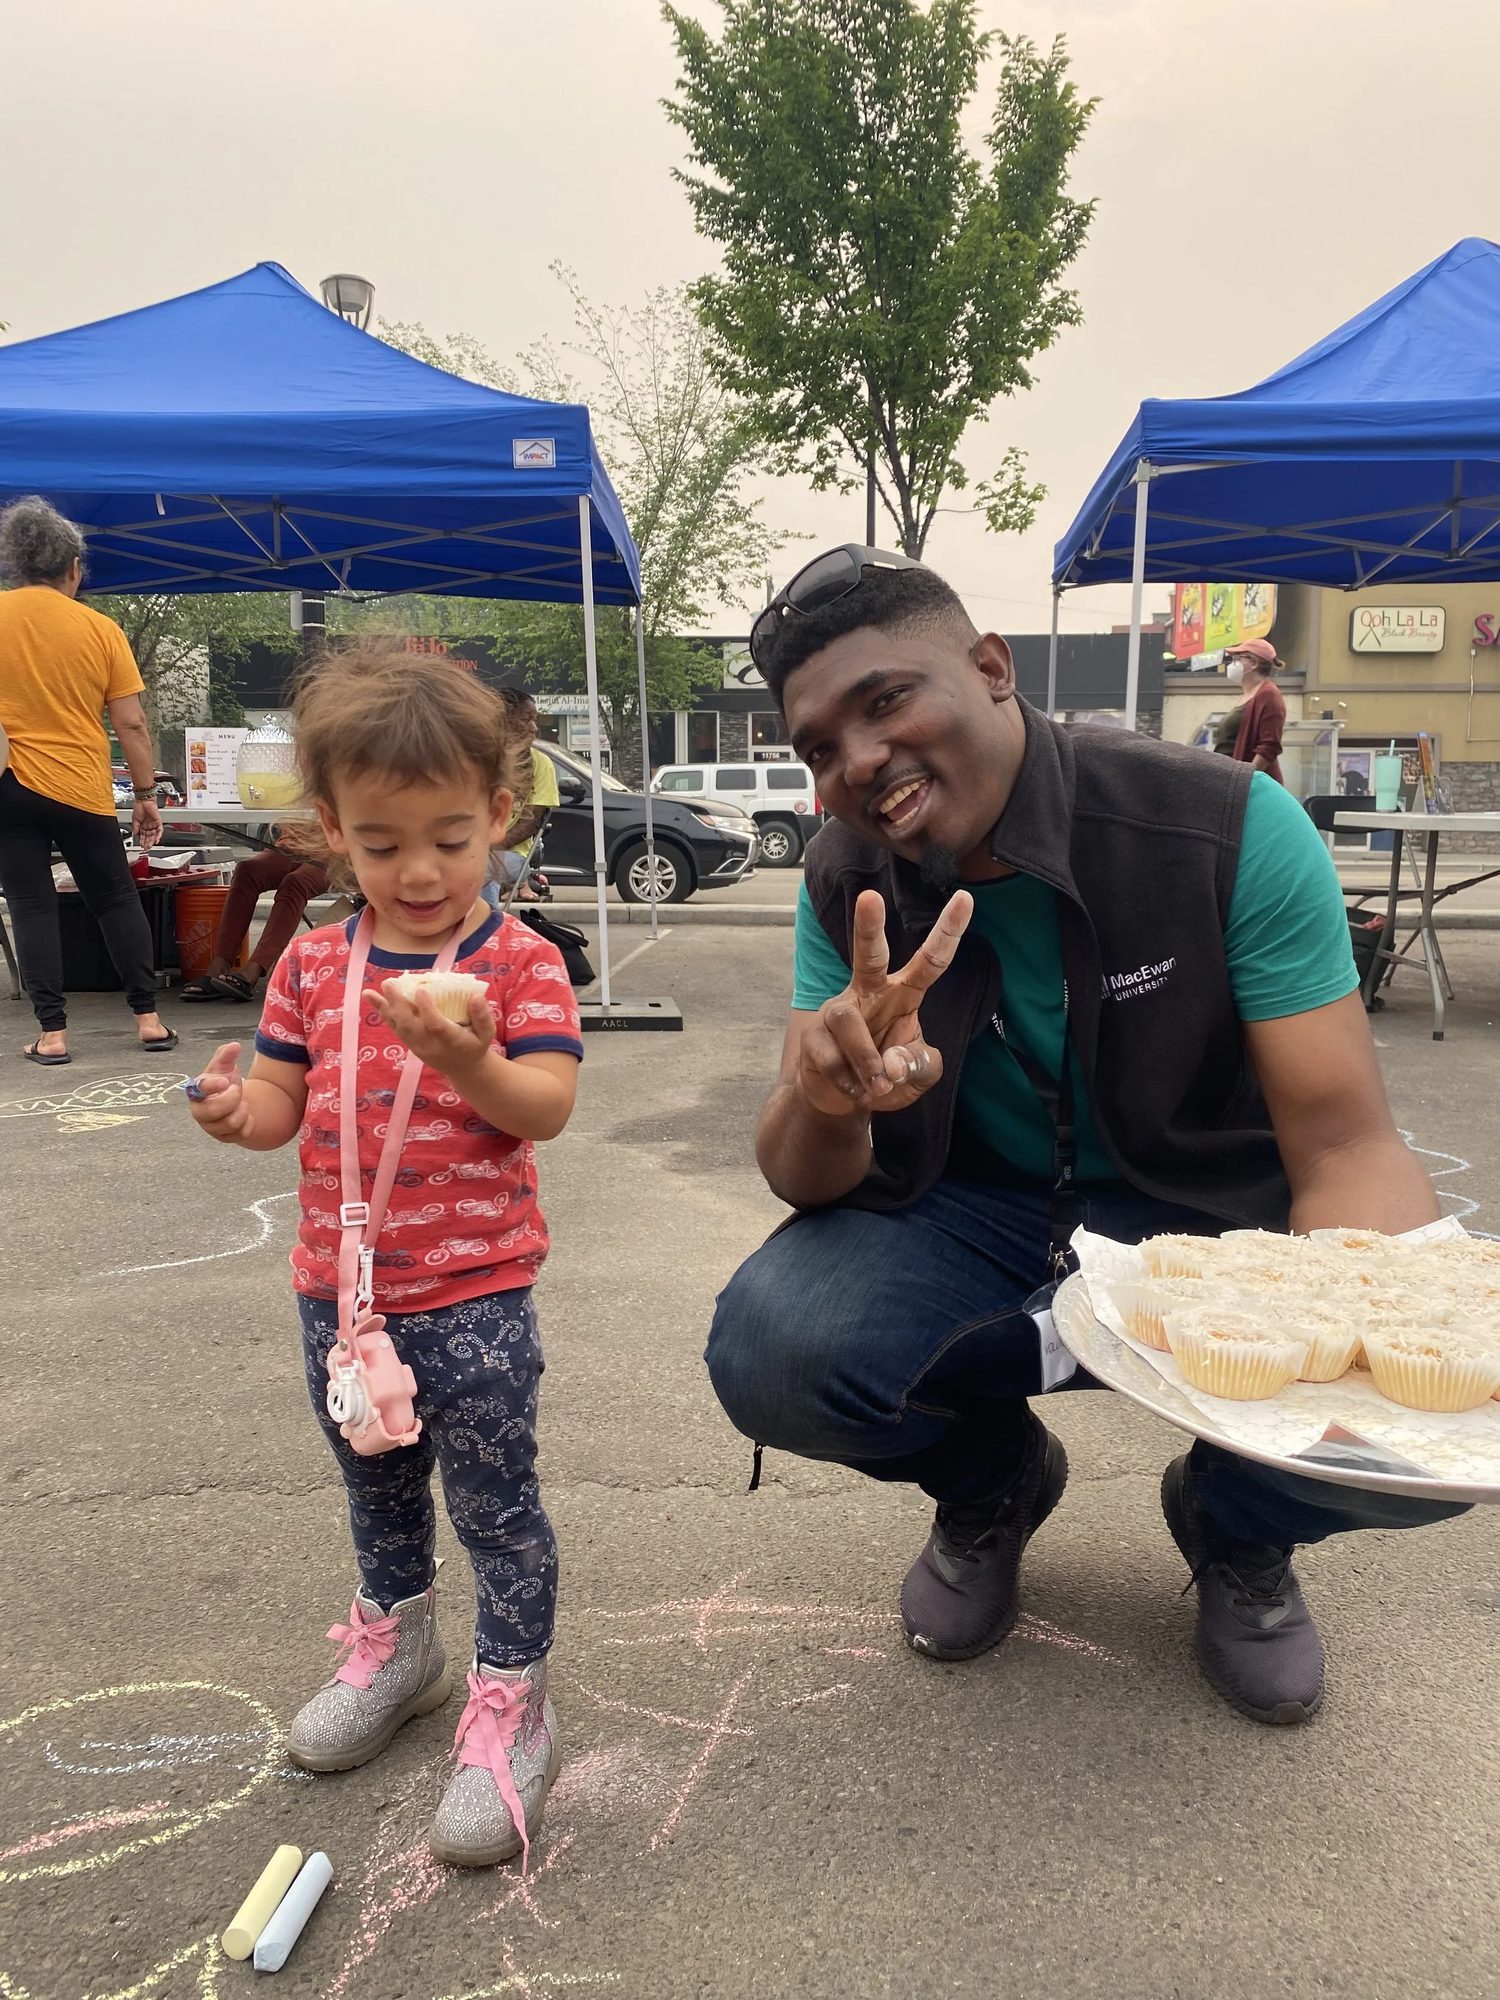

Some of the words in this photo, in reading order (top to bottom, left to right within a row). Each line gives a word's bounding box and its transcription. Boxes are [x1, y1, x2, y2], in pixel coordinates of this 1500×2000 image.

[1360, 610, 1391, 628] Ooh
[1397, 610, 1414, 627] La
[1420, 610, 1438, 627] La
[1110, 957, 1177, 990] MacEwan
[601, 1019, 629, 1028] AACL
